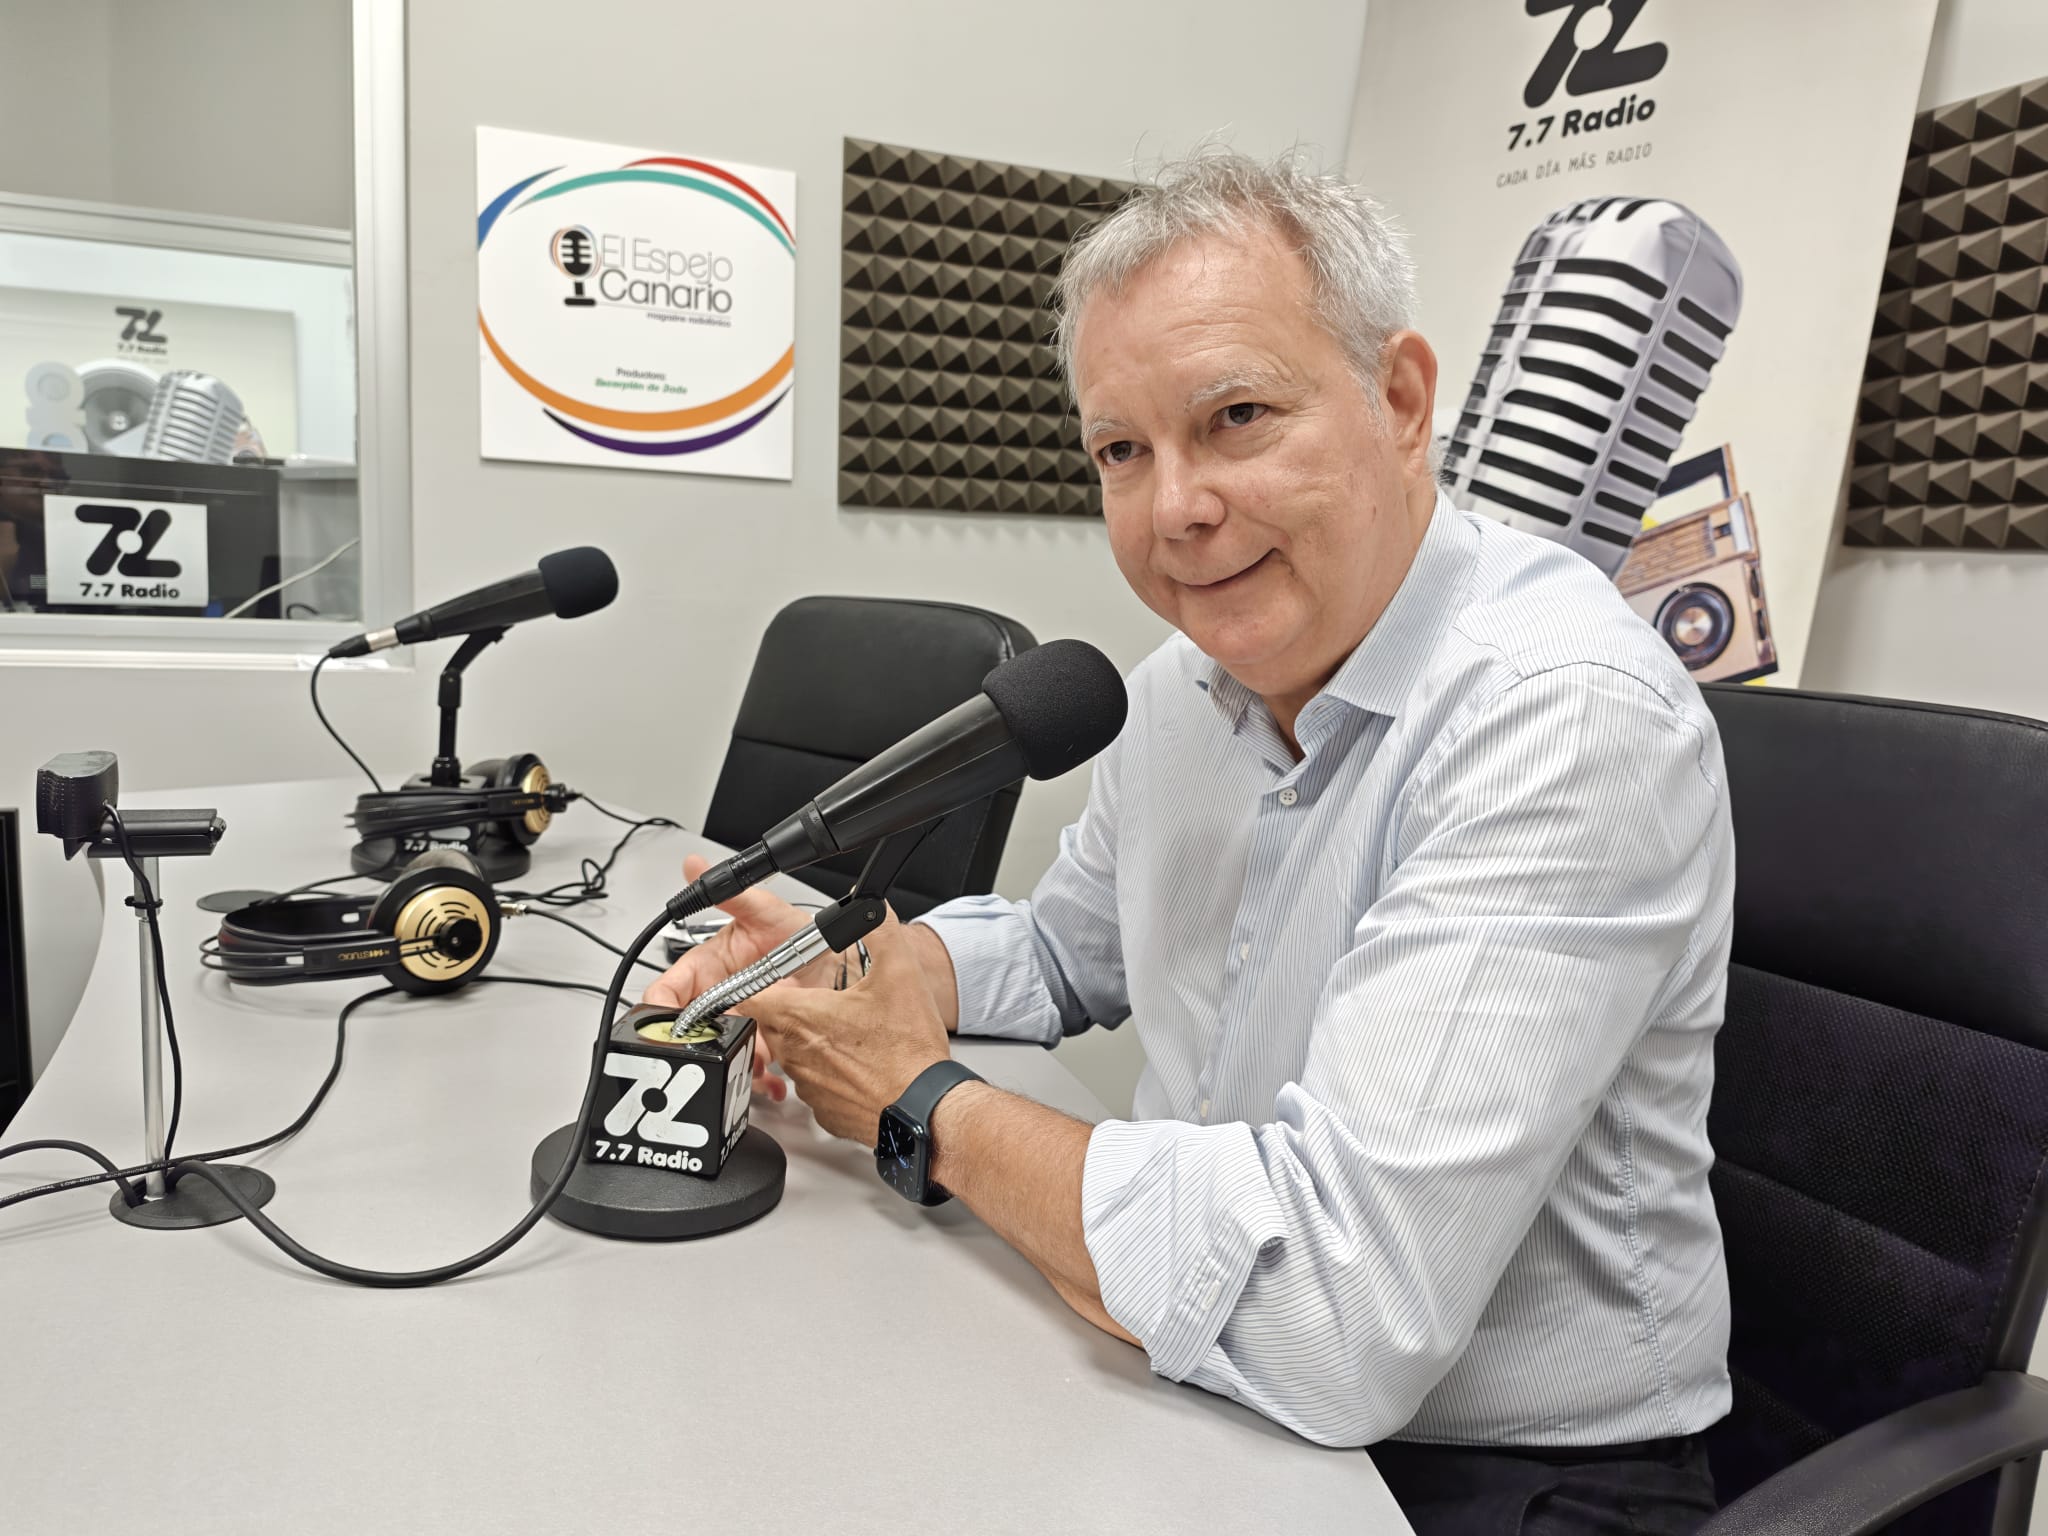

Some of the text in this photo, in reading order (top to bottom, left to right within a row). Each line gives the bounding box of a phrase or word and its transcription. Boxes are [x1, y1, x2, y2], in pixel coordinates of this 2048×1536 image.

[1507, 94, 1656, 151] 7.7 Radio
[1496, 142, 1652, 188] CADA DÍA MÁS RADIO
[601, 233, 733, 285] El Espejo
[599, 268, 733, 314] Canario
[79, 582, 181, 599] 7.7 Radio
[404, 839, 428, 851] 7.7
[595, 1140, 703, 1172] 7.7 Radio
